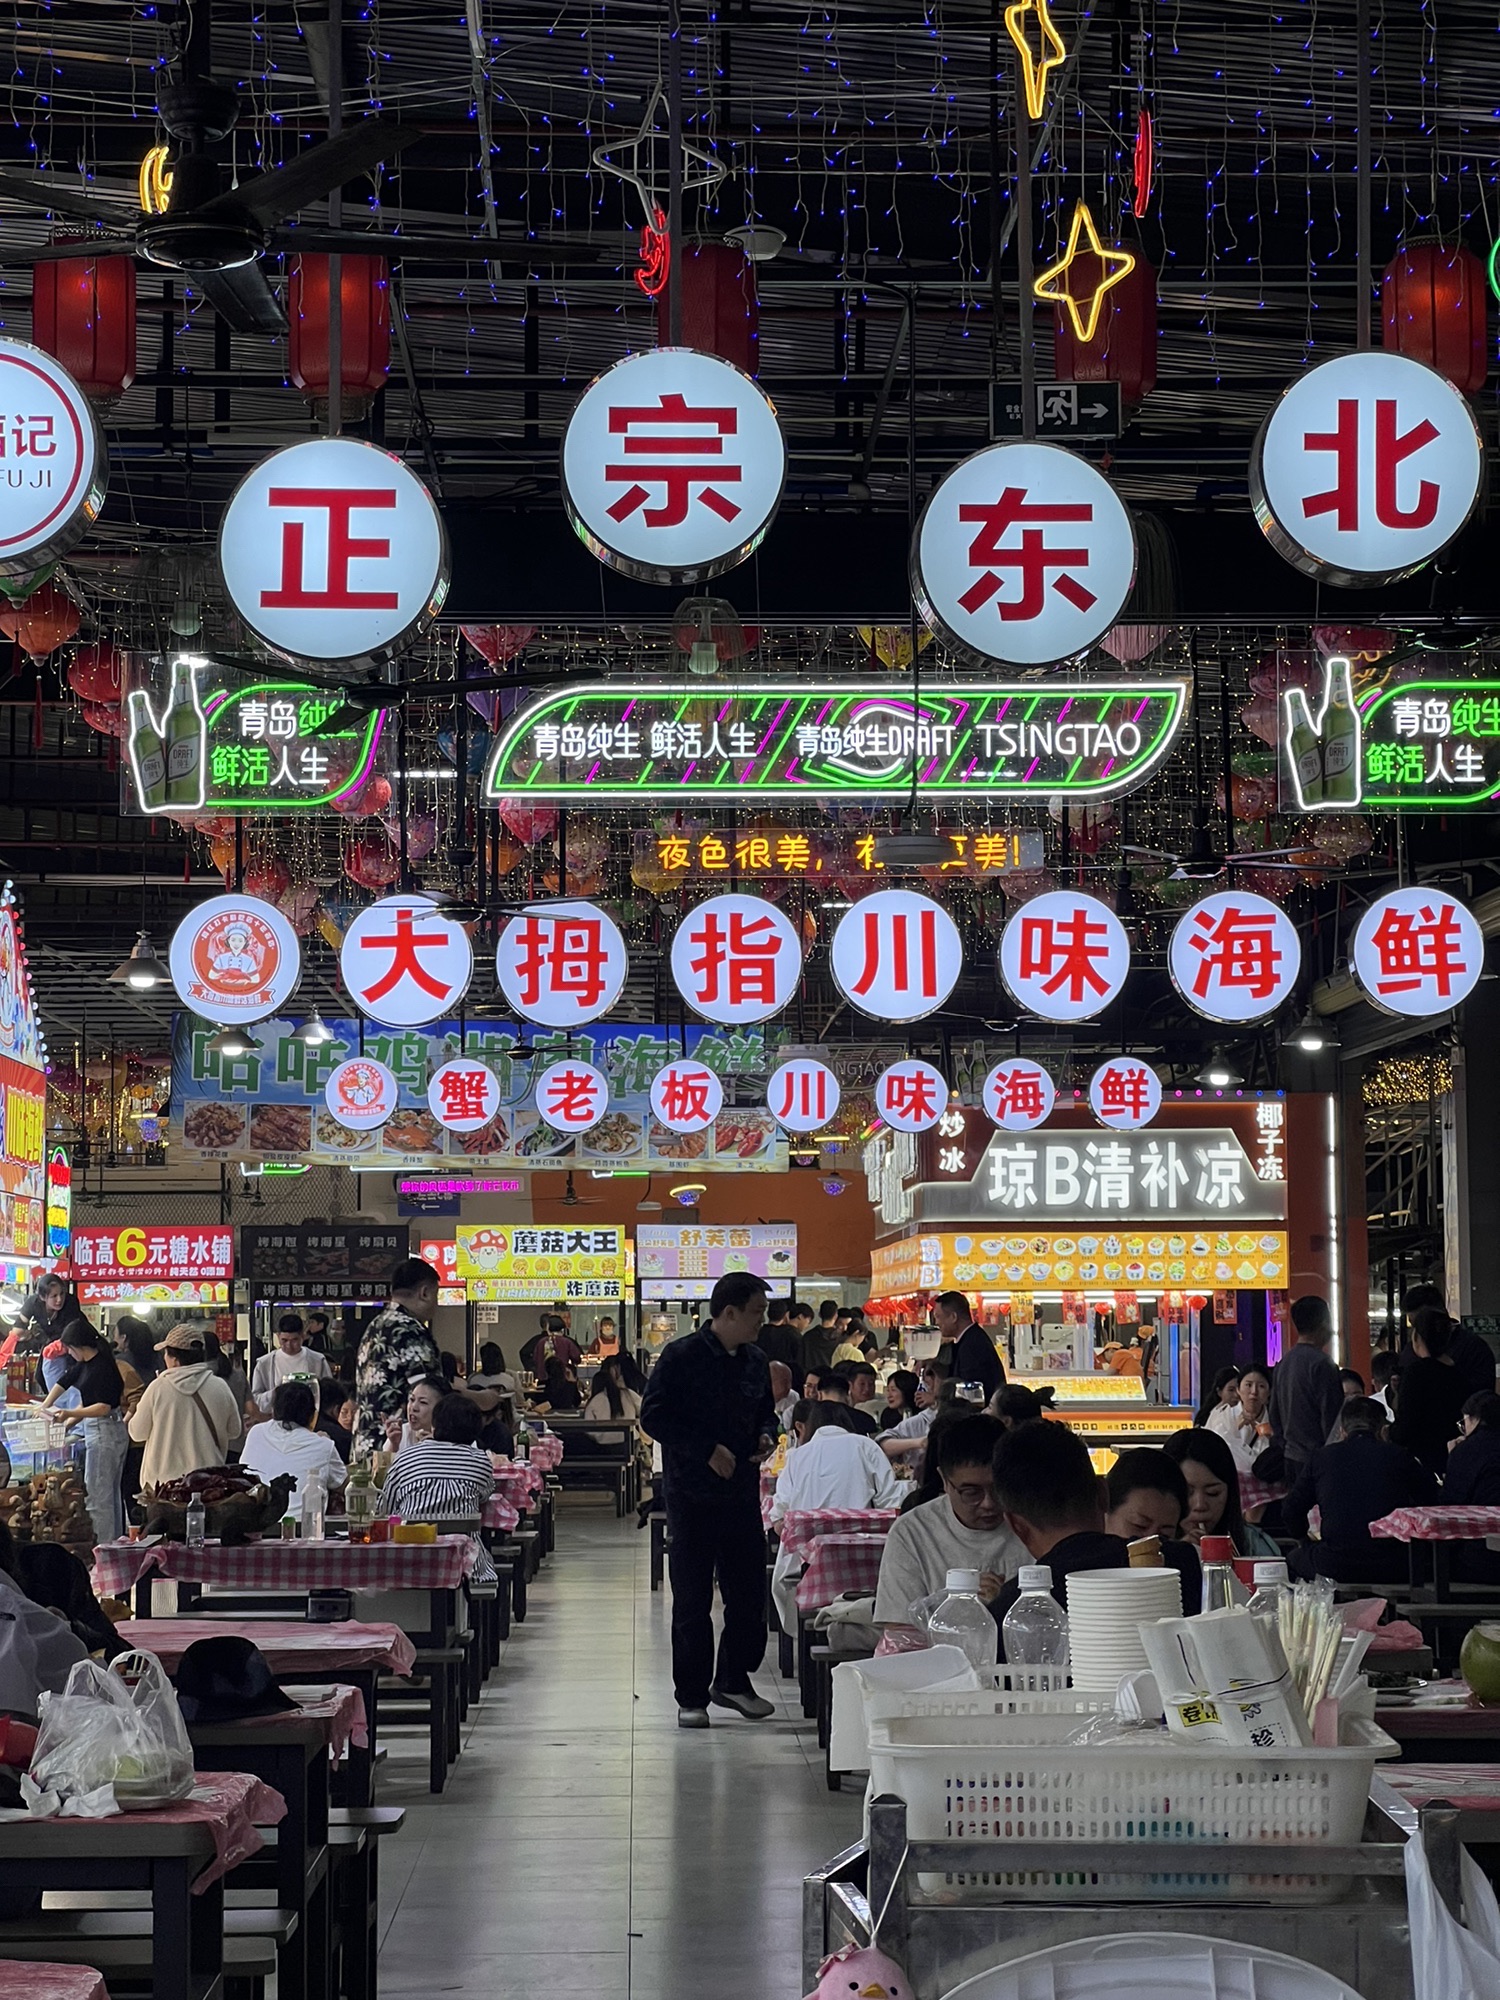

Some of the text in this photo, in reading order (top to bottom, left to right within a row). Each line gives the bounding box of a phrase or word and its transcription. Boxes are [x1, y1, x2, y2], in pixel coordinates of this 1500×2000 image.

[0, 414, 57, 457] 记
[533, 722, 641, 761] 青岛纯生
[650, 720, 757, 760] 鲜活人生
[975, 722, 1141, 757] TSINGTAO
[211, 744, 330, 787] 鲜活人生
[1366, 743, 1485, 783] 鲜活人生
[938, 1111, 966, 1173] 炒冰
[1256, 1102, 1284, 1181] 椰子冻
[988, 1141, 1245, 1209] 琼B清补凉
[74, 1227, 231, 1266] 临高6元糖水铺
[258, 1236, 297, 1248] 烤海胆
[307, 1236, 346, 1247] 烤海星
[514, 1231, 617, 1253] 蘑菇大王
[680, 1228, 751, 1247] 舒芙蕾
[263, 1284, 392, 1297] 烤海胆 烤海星 烤扇
[566, 1280, 619, 1297] 炸蘑菇
